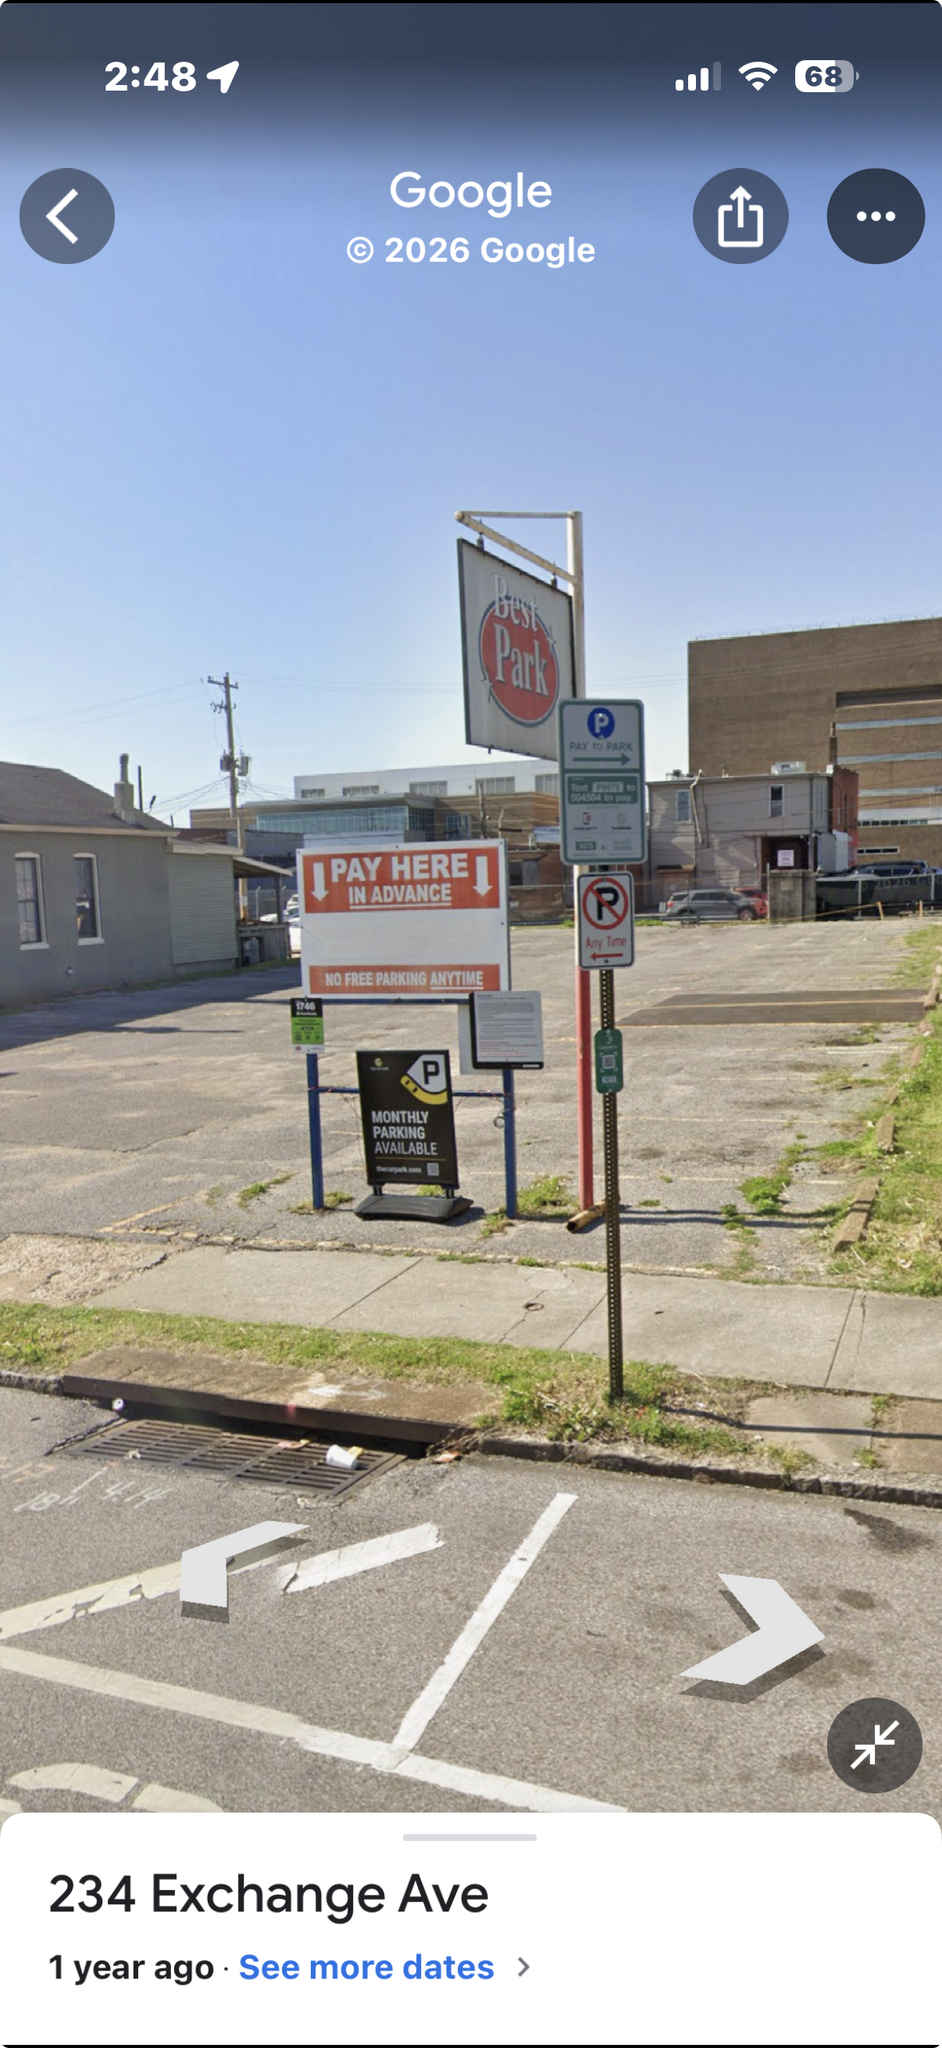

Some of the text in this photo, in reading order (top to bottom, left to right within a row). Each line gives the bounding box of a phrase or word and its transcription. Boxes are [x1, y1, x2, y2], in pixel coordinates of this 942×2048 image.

[494, 574, 539, 632] Best
[494, 623, 549, 696] Park
[569, 742, 588, 750] PAY
[606, 742, 633, 750] PARK
[570, 783, 589, 792] Text
[331, 853, 469, 883] PAY HERE
[349, 883, 451, 905] IN ADVANCE
[586, 936, 627, 951] Any Time
[325, 970, 484, 987] NO FREE PARKING ANYTIME
[371, 1110, 429, 1124] MONTHLY
[373, 1126, 426, 1139] PARKING
[374, 1142, 438, 1156] AVAILABLE
[376, 1165, 422, 1174] thecarpark.com
